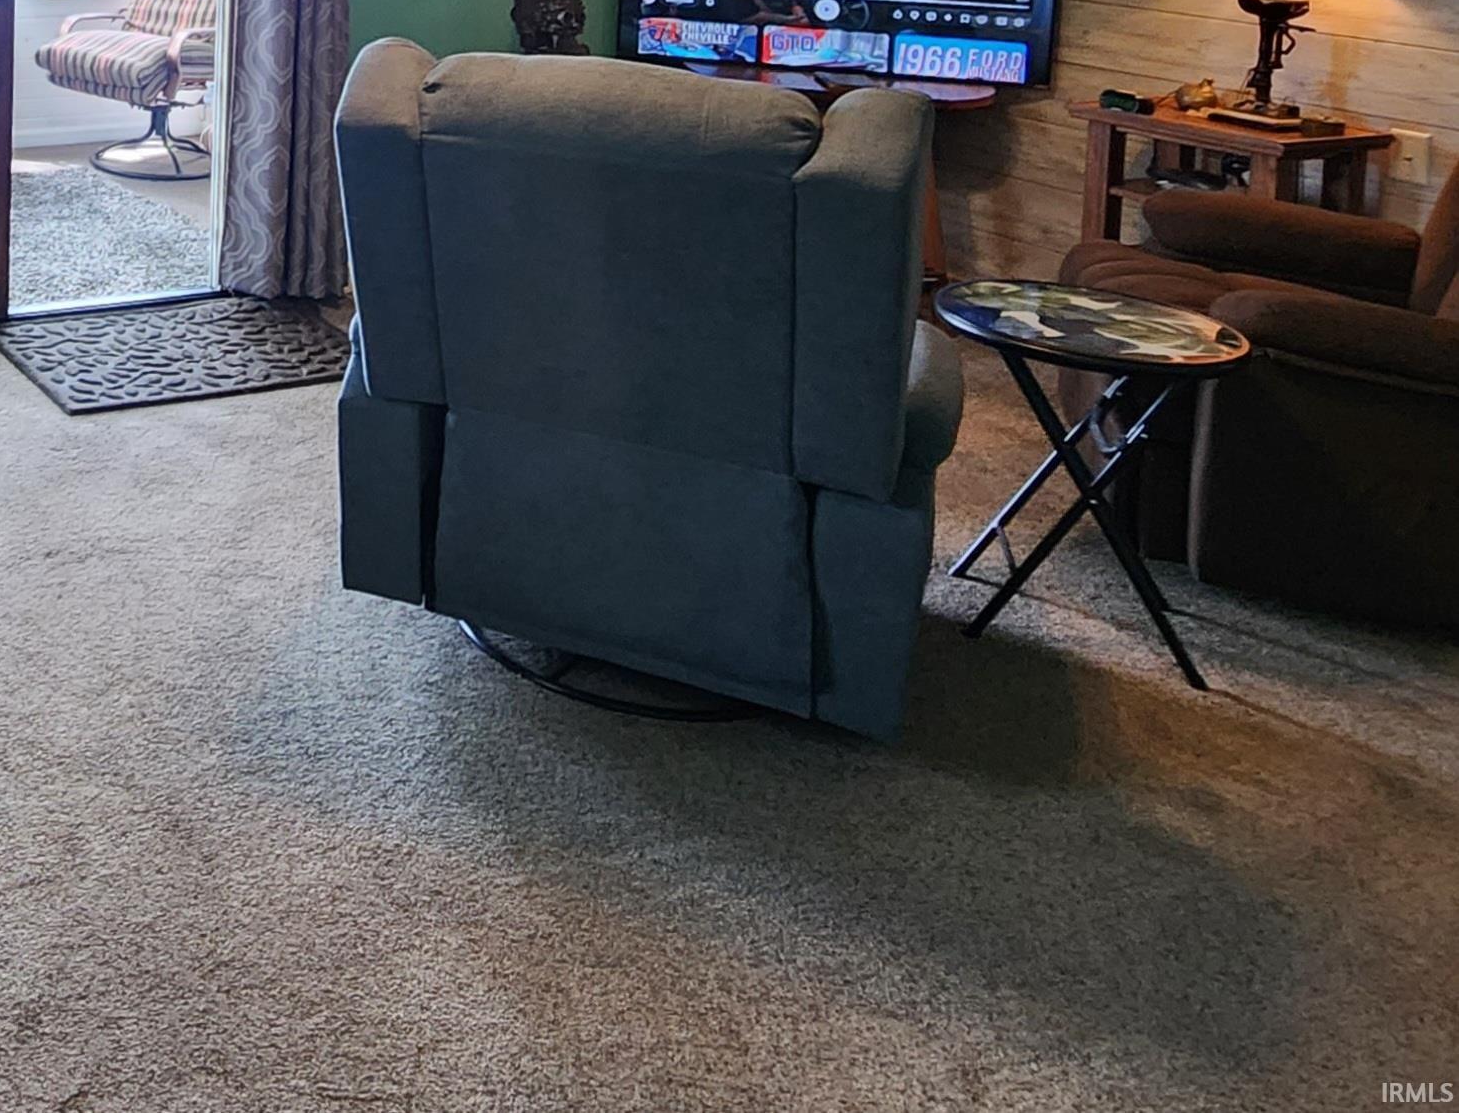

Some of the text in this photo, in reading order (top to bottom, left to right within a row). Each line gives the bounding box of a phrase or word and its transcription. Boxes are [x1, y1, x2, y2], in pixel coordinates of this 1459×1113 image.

[771, 33, 815, 54] GTO
[898, 43, 1023, 77] 1966 FORD
